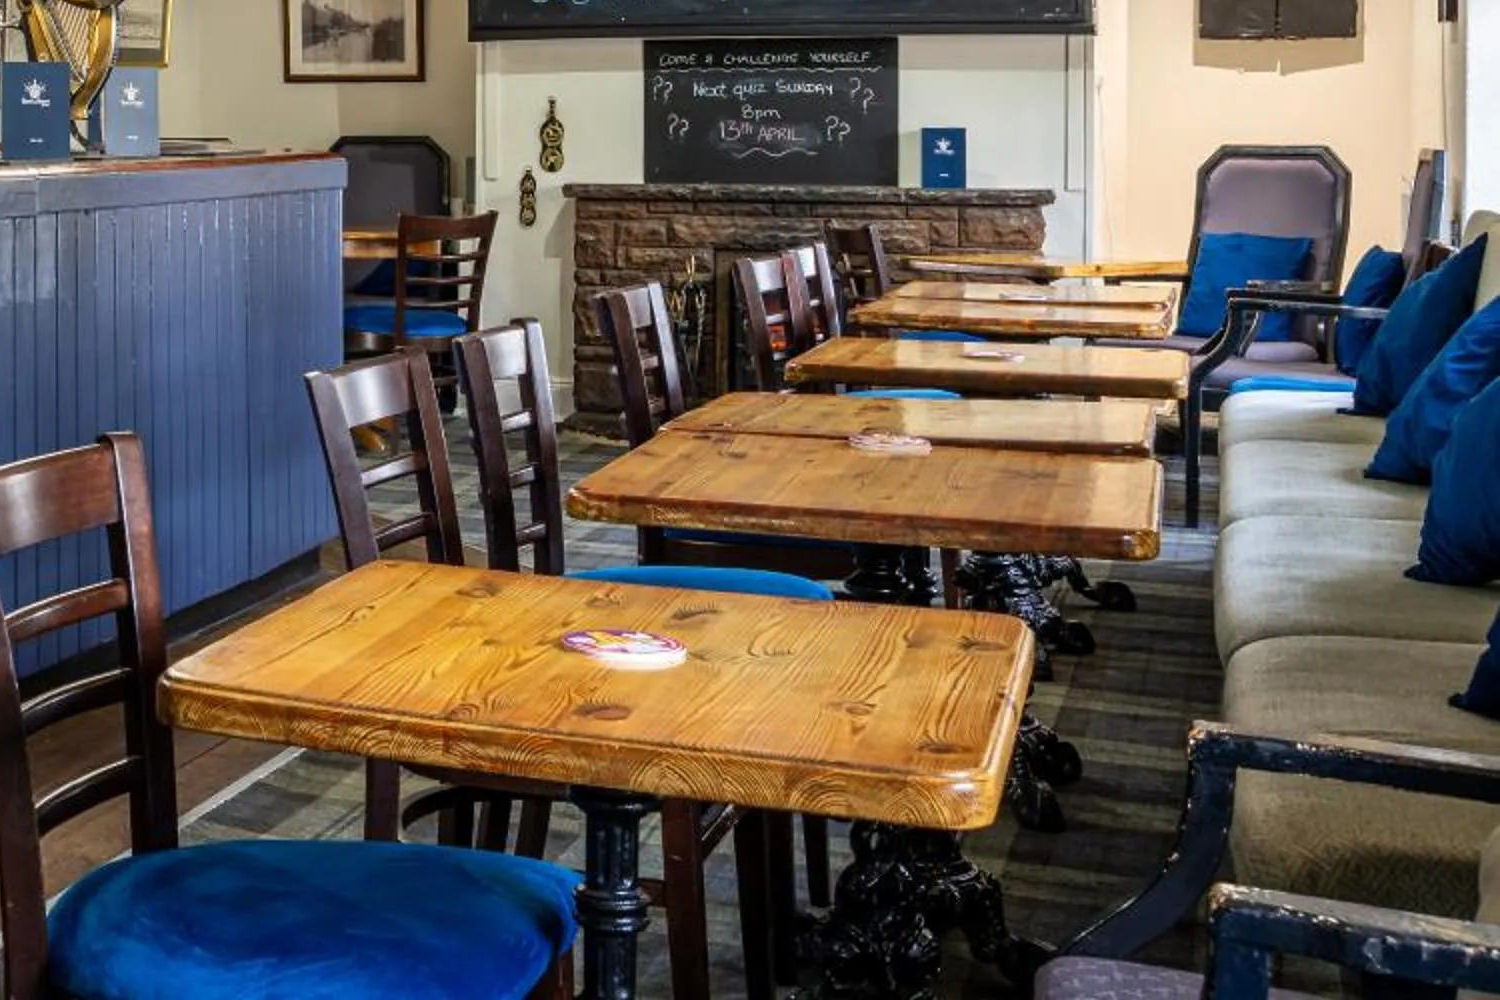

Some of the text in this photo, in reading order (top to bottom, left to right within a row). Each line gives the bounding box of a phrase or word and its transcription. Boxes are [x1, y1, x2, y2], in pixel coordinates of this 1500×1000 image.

[659, 53, 697, 67] COME
[723, 51, 799, 65] CHALLENGE
[809, 50, 872, 64] YOURSELF
[692, 81, 728, 98] Next
[739, 103, 782, 121] 8pm
[718, 119, 808, 143] 13th APRIL
